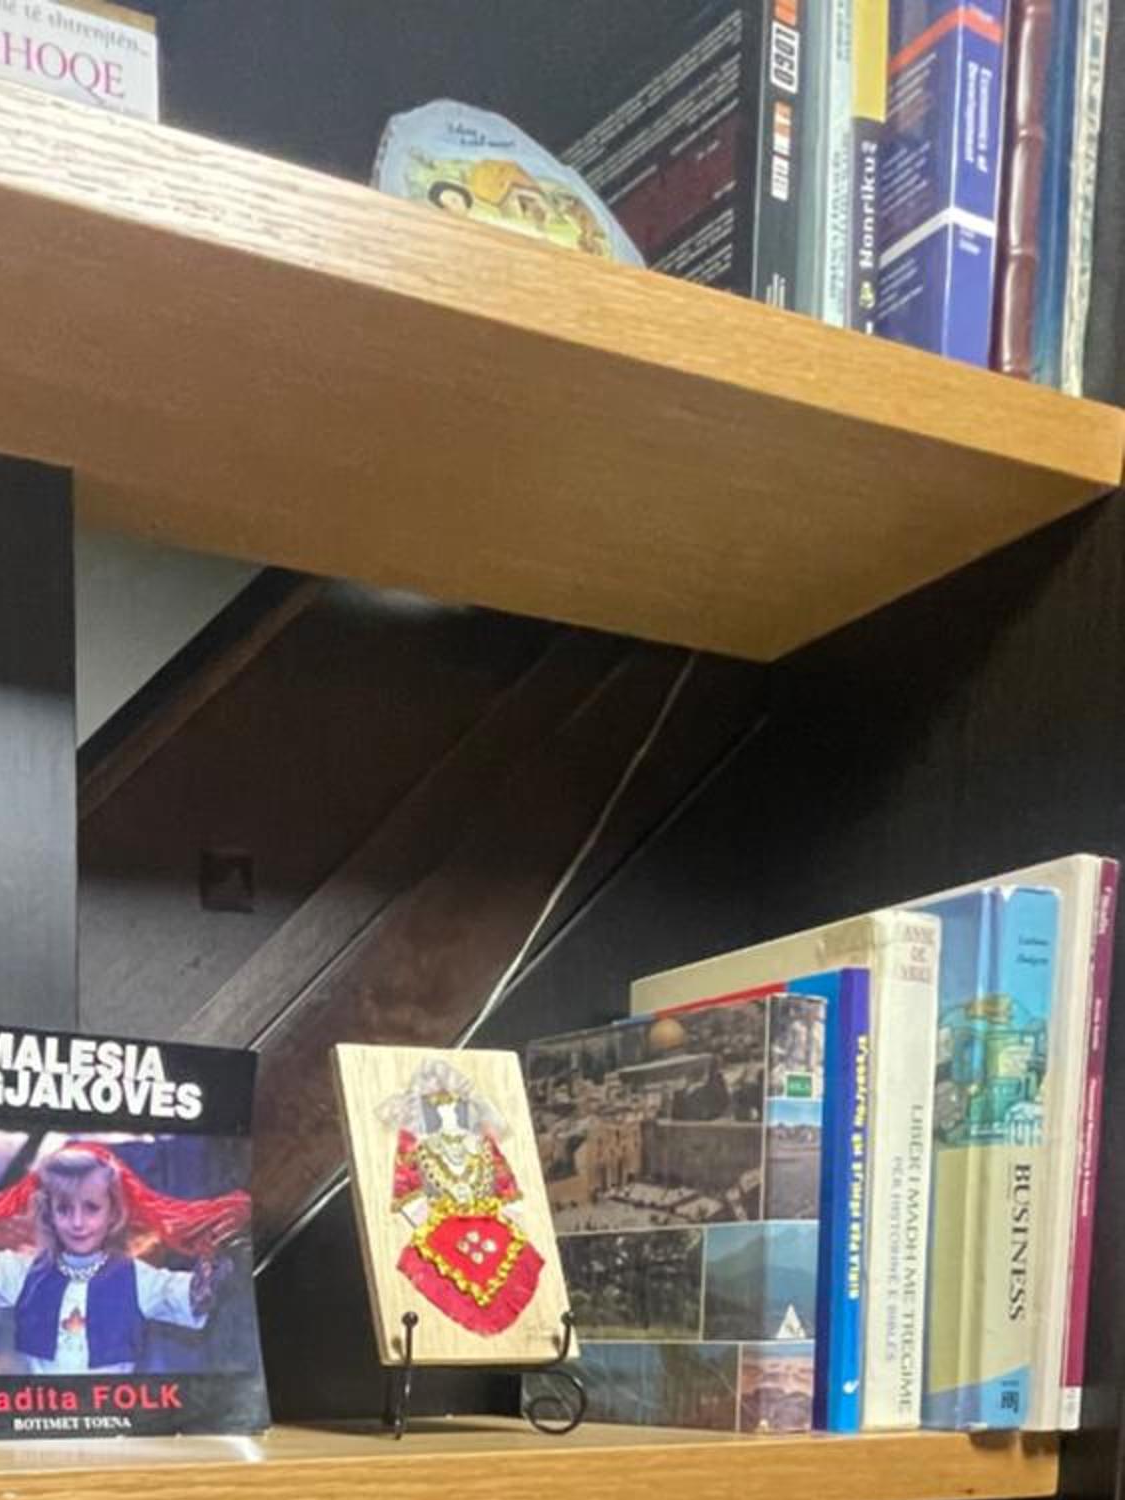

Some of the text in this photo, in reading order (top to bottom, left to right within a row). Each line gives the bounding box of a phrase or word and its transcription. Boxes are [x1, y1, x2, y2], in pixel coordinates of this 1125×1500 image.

[905, 1186, 922, 1260] MADH
[1008, 1163, 1033, 1322] BUSINESS
[902, 1265, 918, 1303] ME
[896, 1309, 917, 1413] TREGIME
[13, 1416, 132, 1431] BOTIMET TOENA
[93, 1384, 182, 1409] FOLK
